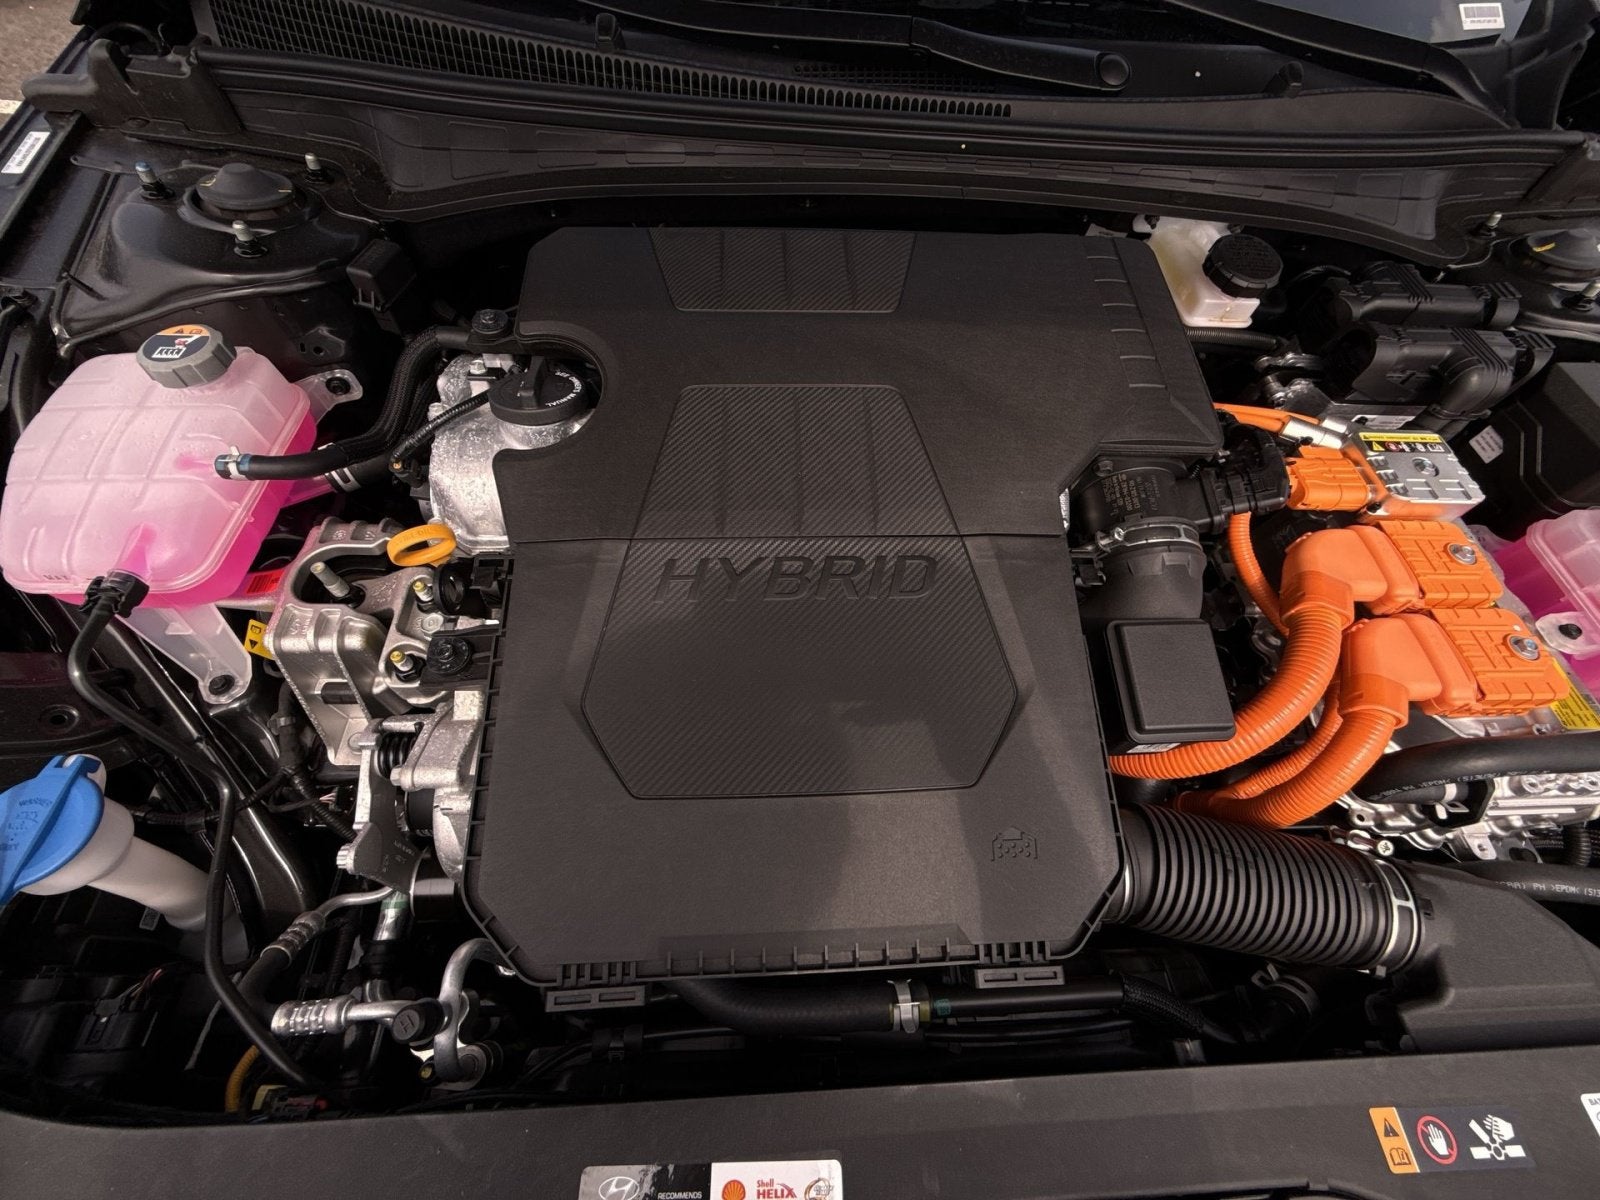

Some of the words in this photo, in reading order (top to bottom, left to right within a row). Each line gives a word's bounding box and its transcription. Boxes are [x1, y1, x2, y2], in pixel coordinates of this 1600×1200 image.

[653, 554, 938, 603] HYBRID
[1532, 882, 1546, 891] PH
[756, 1179, 774, 1188] Shell
[657, 1191, 702, 1200] RECOMMENDS
[756, 1187, 798, 1199] HELIX
